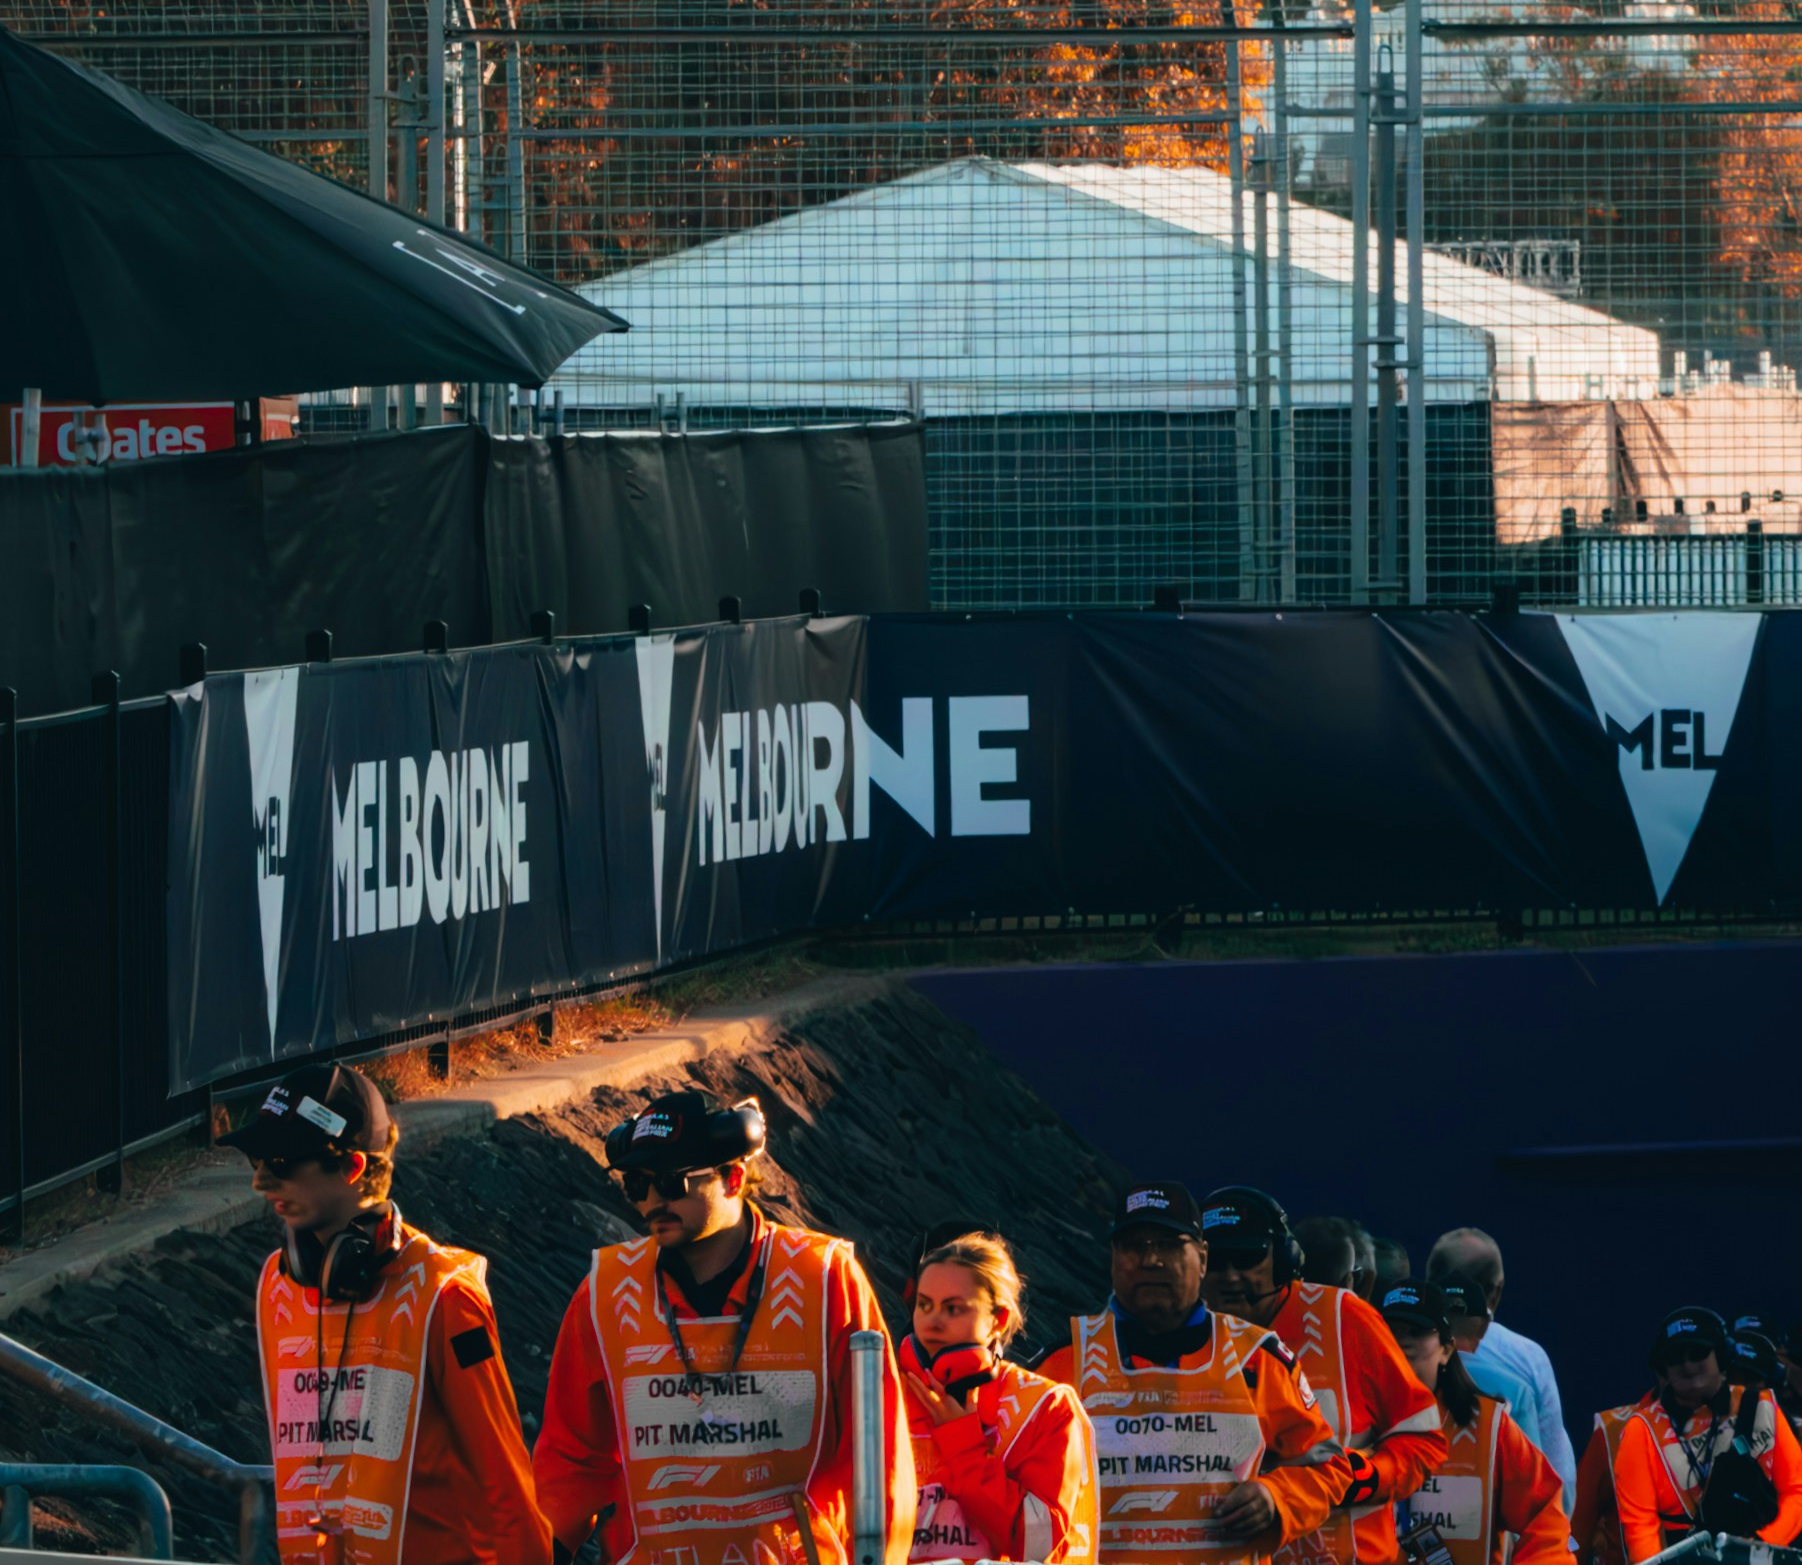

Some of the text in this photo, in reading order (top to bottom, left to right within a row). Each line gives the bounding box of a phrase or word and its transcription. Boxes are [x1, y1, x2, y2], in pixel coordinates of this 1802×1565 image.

[1605, 709, 1723, 771] MEL
[699, 696, 1031, 867] MELBOURNE
[254, 796, 287, 879] MEL
[332, 741, 530, 941] MELBOURNE
[278, 1420, 306, 1444] PIT
[635, 1418, 783, 1448] PIT MARSHAL
[1115, 1414, 1218, 1435] 0070-MEL
[1099, 1454, 1233, 1476] PIT MARSHAL
